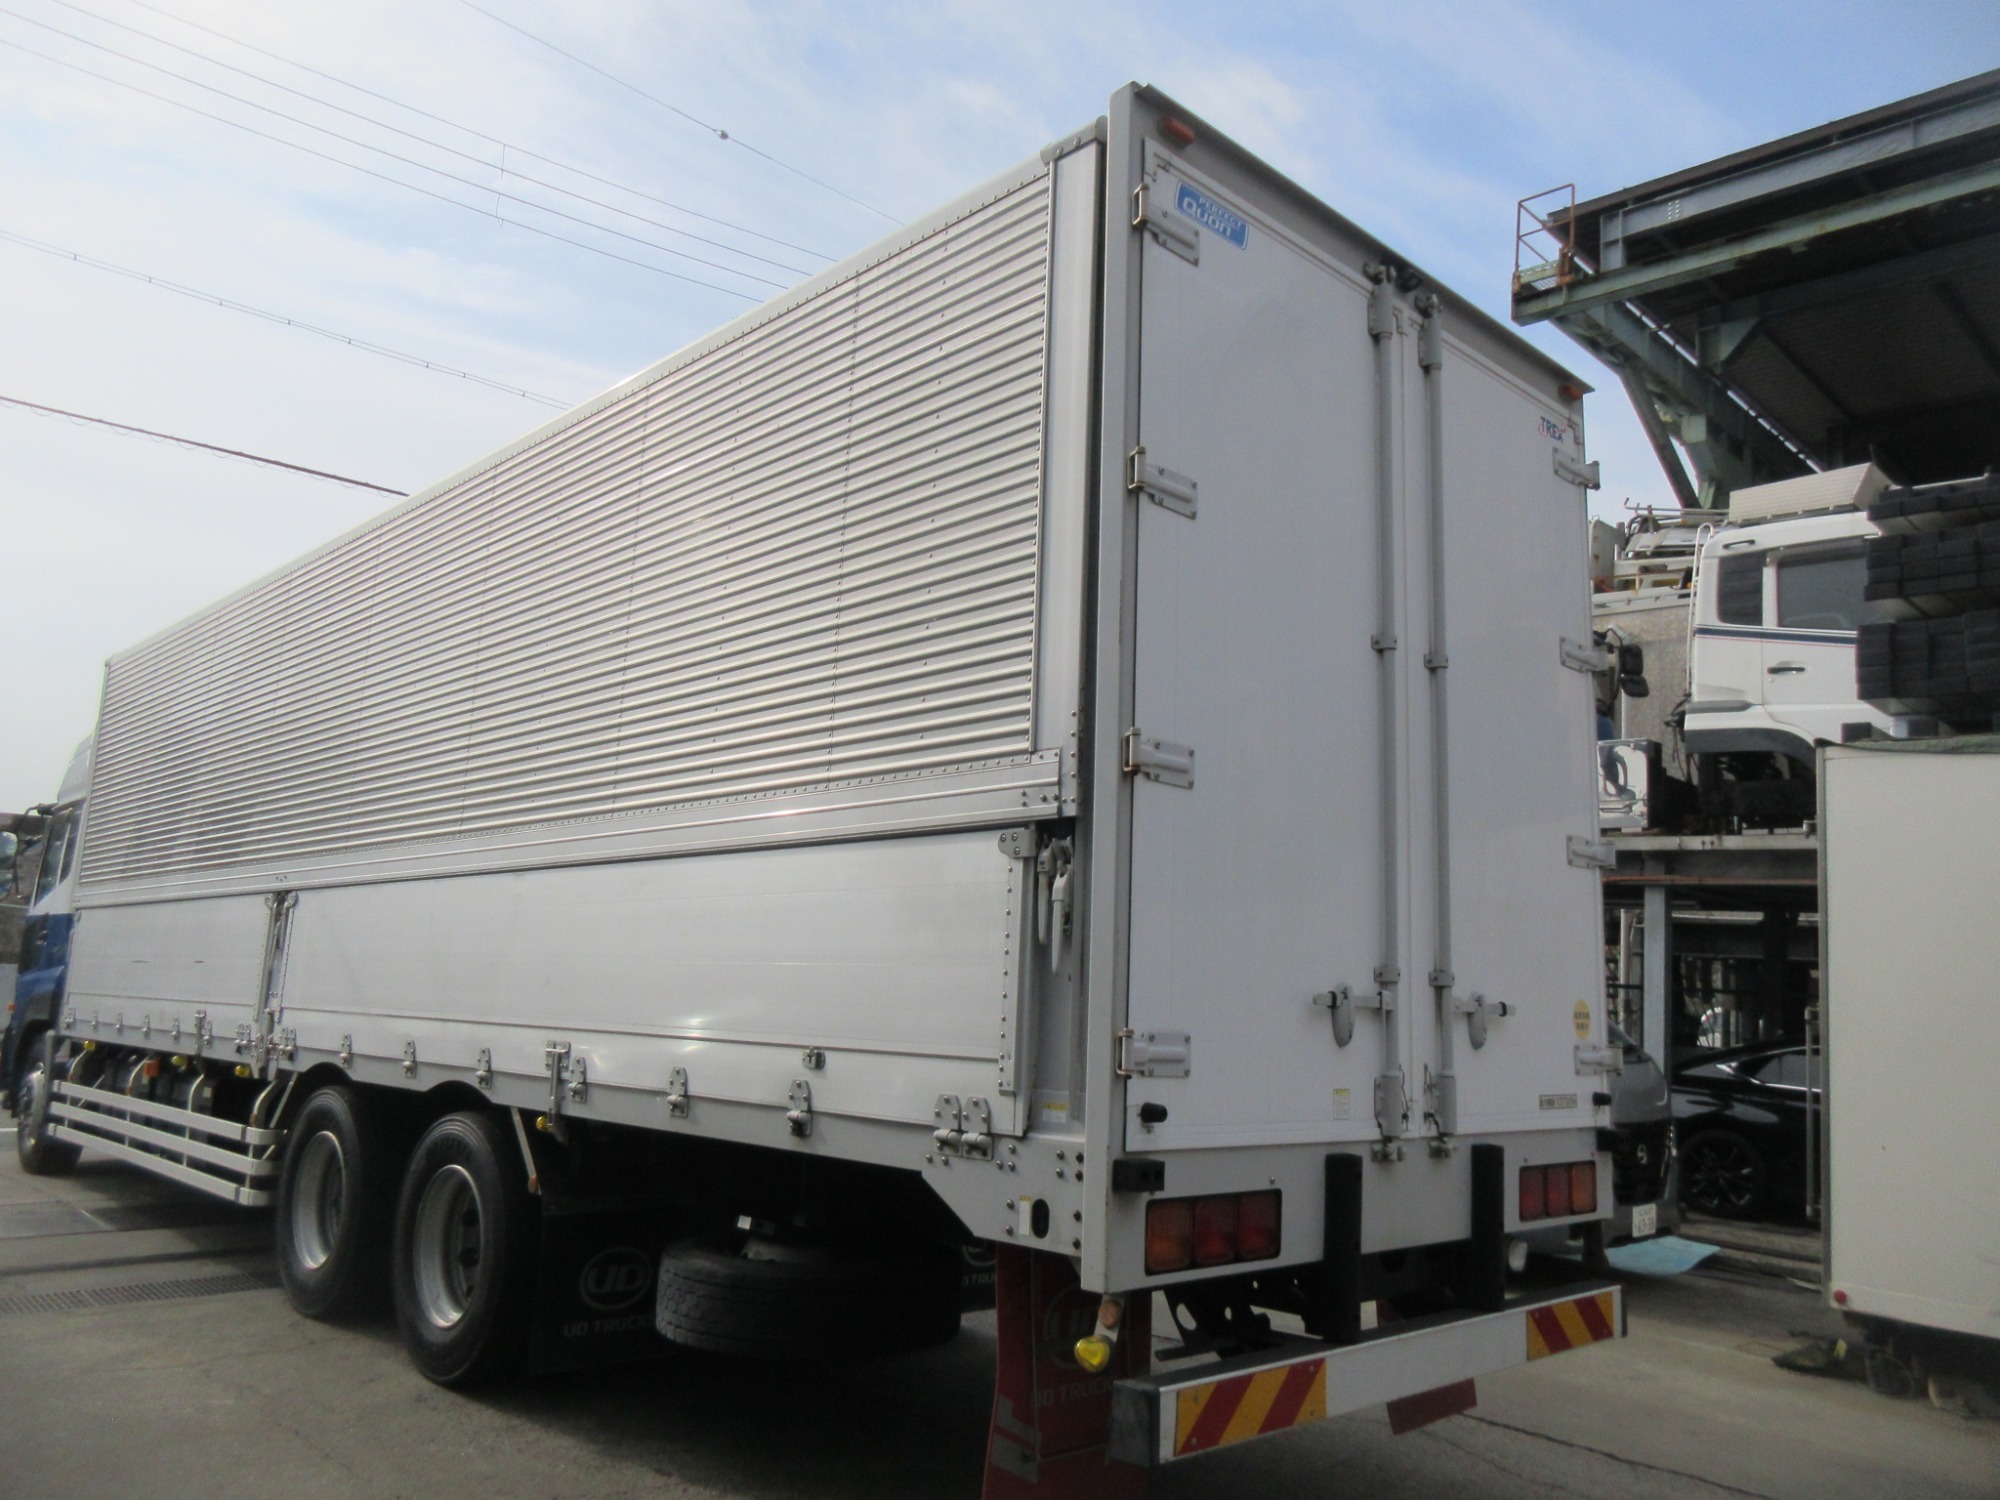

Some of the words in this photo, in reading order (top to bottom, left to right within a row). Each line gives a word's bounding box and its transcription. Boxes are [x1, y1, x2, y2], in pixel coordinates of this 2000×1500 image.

[587, 1265, 646, 1293] UD
[563, 1321, 588, 1338] UD
[592, 1315, 654, 1333] TRUCK
[1059, 1377, 1112, 1402] TRUCK
